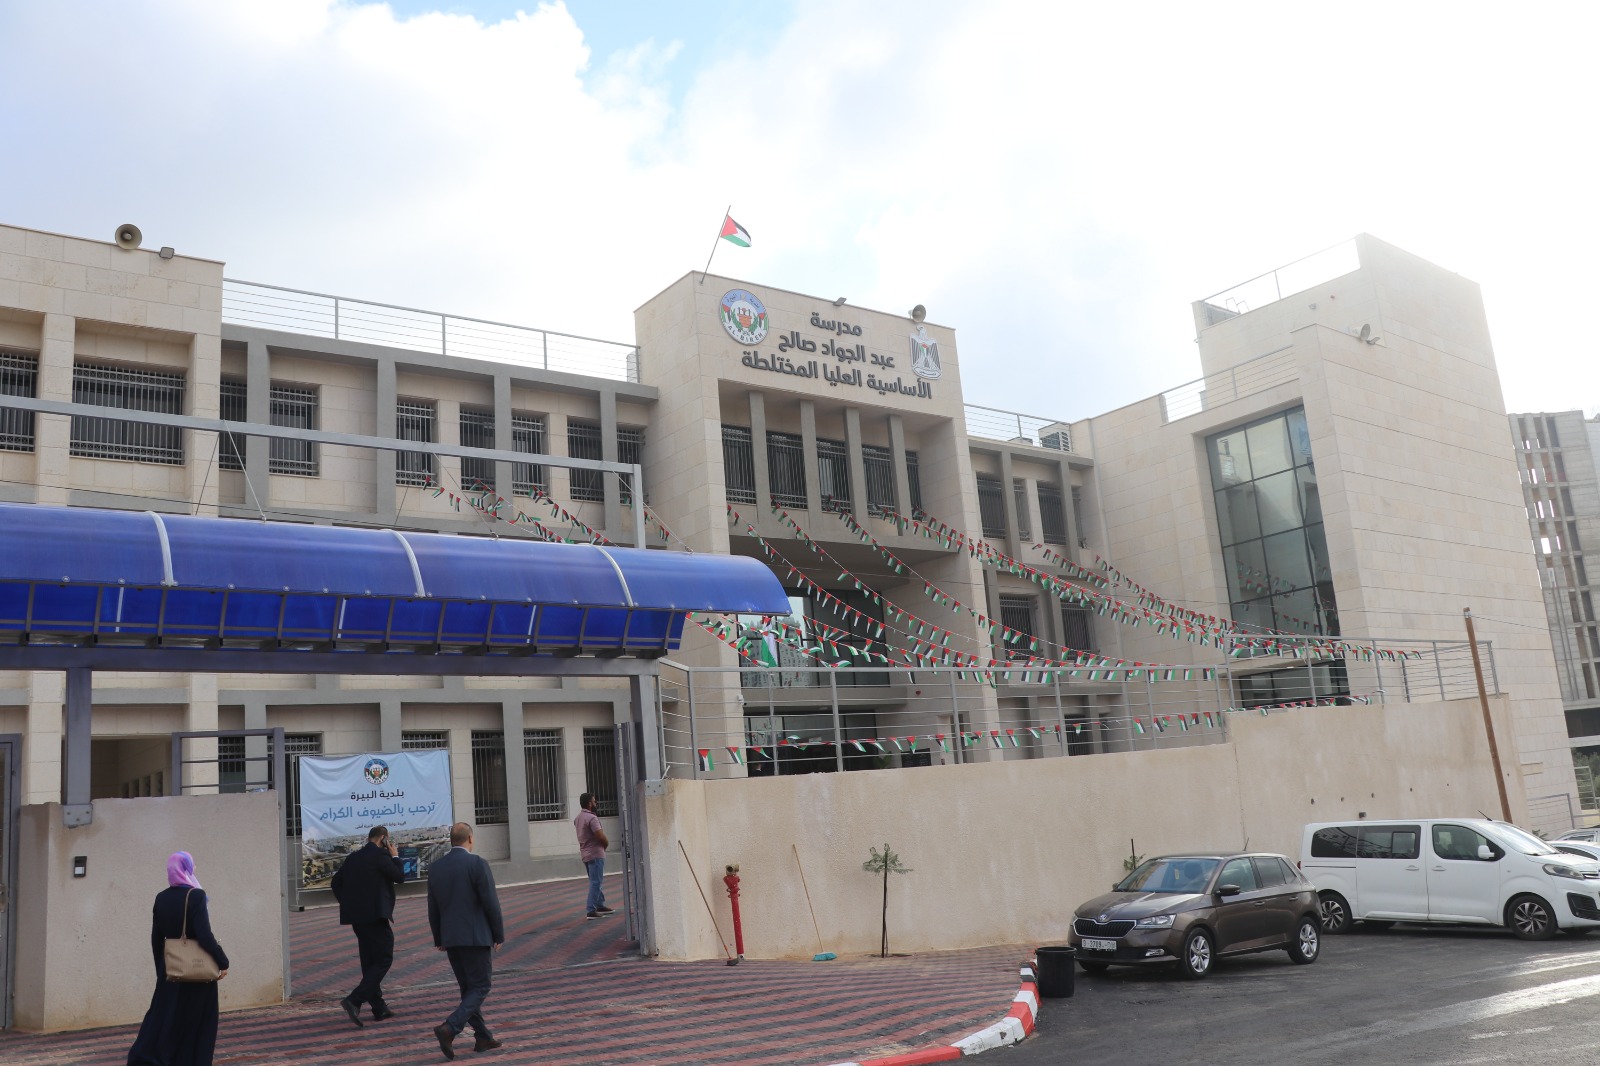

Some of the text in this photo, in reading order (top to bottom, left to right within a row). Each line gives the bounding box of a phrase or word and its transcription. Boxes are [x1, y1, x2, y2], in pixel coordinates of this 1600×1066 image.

[810, 311, 863, 337] مدرسة
[778, 330, 896, 370] عبد الجواد صالح
[741, 350, 933, 400] الأساسية العليا المختلطة
[350, 788, 405, 802] بلدية البيرة
[319, 802, 436, 822] ترحب بالضيوف الكرام
